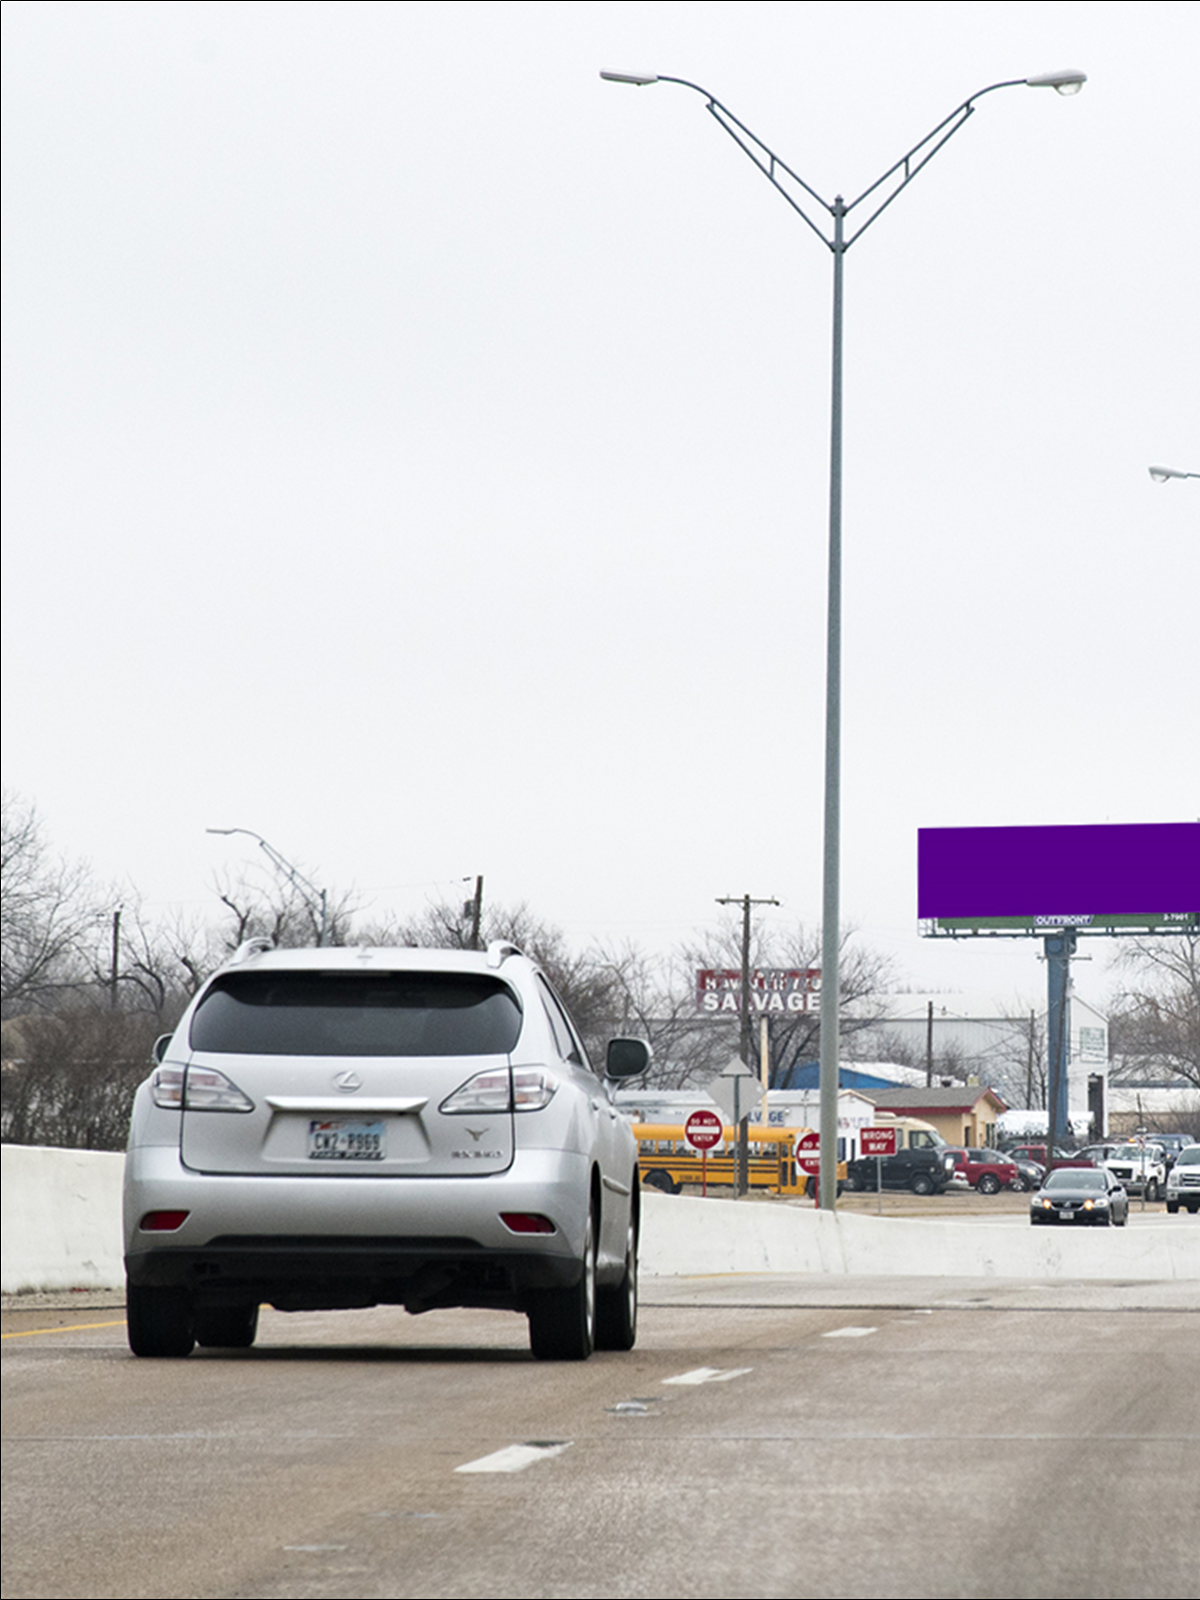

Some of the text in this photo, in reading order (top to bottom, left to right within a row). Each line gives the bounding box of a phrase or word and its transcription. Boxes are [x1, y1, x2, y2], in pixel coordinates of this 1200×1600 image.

[691, 1117, 716, 1126] DO NOT
[693, 1134, 714, 1142] ENTER
[862, 1130, 894, 1141] WRONG
[802, 1141, 813, 1149] DO
[868, 1142, 888, 1152] WAY
[805, 1159, 820, 1167] ENT
